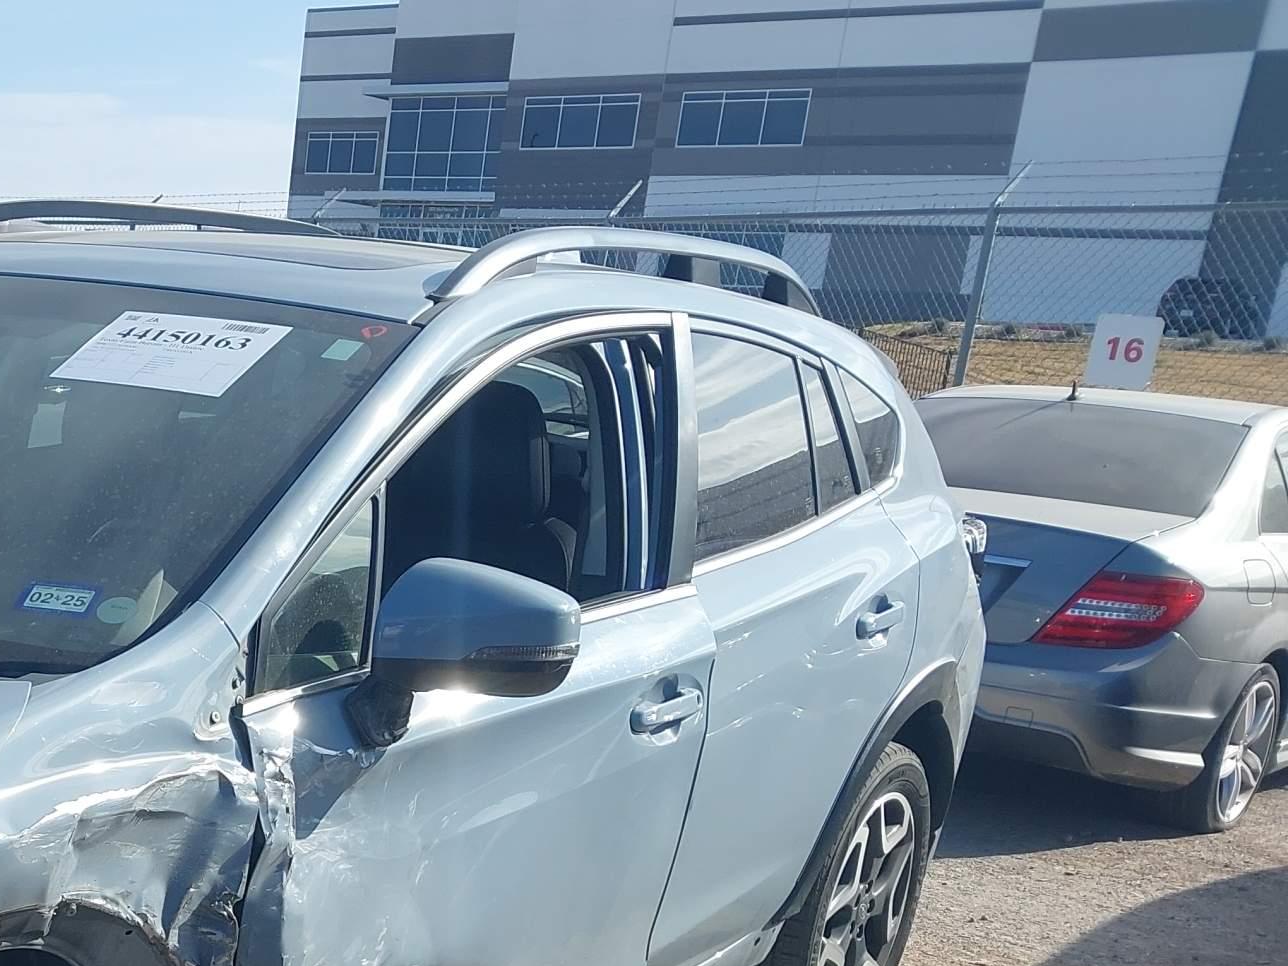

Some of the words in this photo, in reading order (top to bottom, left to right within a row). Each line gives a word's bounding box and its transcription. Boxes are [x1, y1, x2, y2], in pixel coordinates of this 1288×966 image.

[116, 326, 252, 350] 44150163
[1107, 337, 1145, 363] 16
[30, 591, 55, 604] 02
[61, 594, 89, 607] 25
